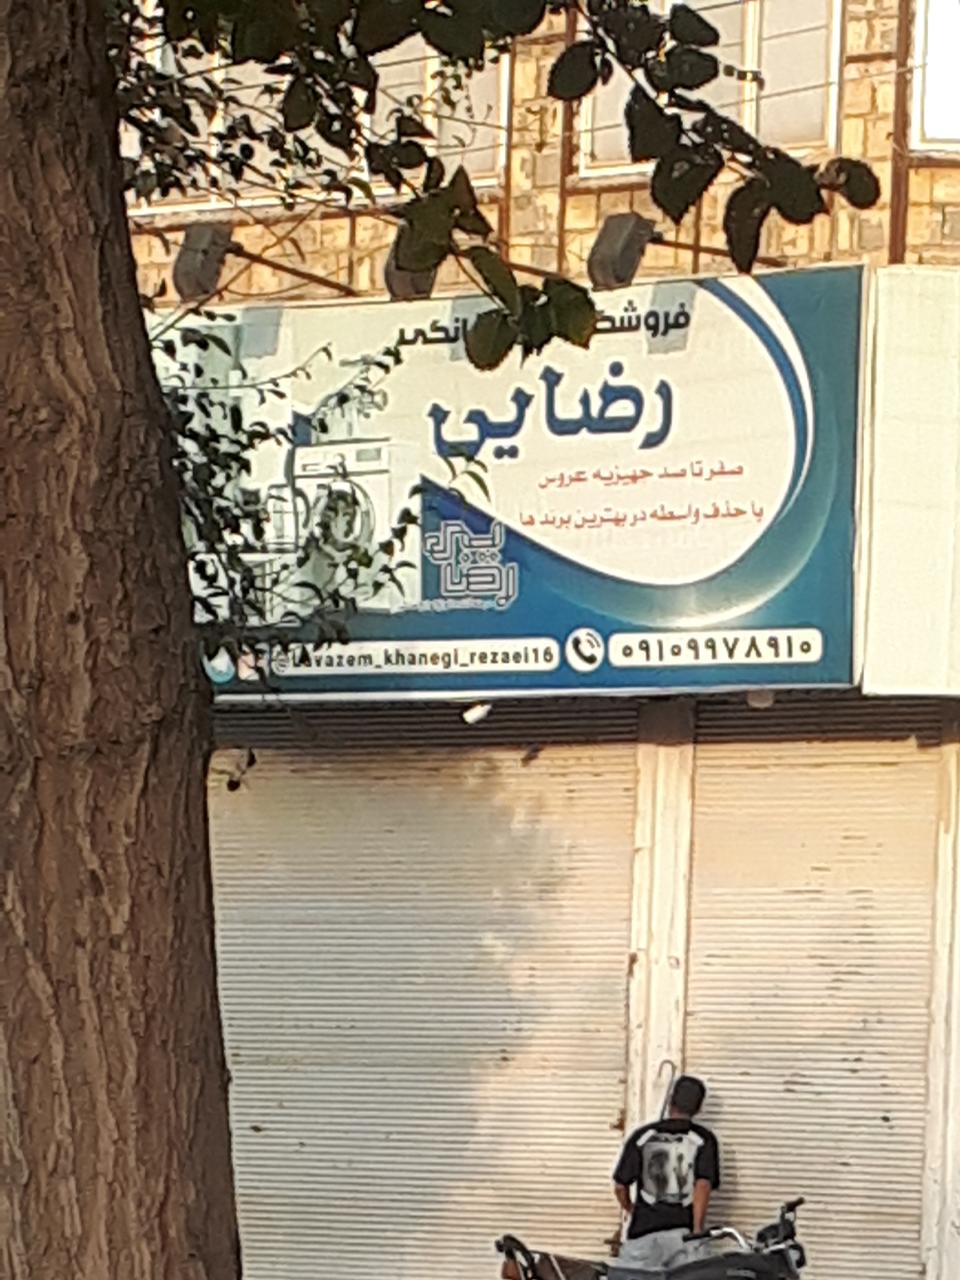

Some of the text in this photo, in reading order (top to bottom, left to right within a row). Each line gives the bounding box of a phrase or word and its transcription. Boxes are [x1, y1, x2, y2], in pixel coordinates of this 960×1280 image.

[427, 361, 673, 460] رضایی
[658, 464, 688, 478] صد
[689, 459, 703, 478] تا
[538, 469, 588, 489] عروس
[574, 506, 627, 529] بهترین
[649, 503, 700, 525] واسطه
[702, 501, 747, 520] حذف
